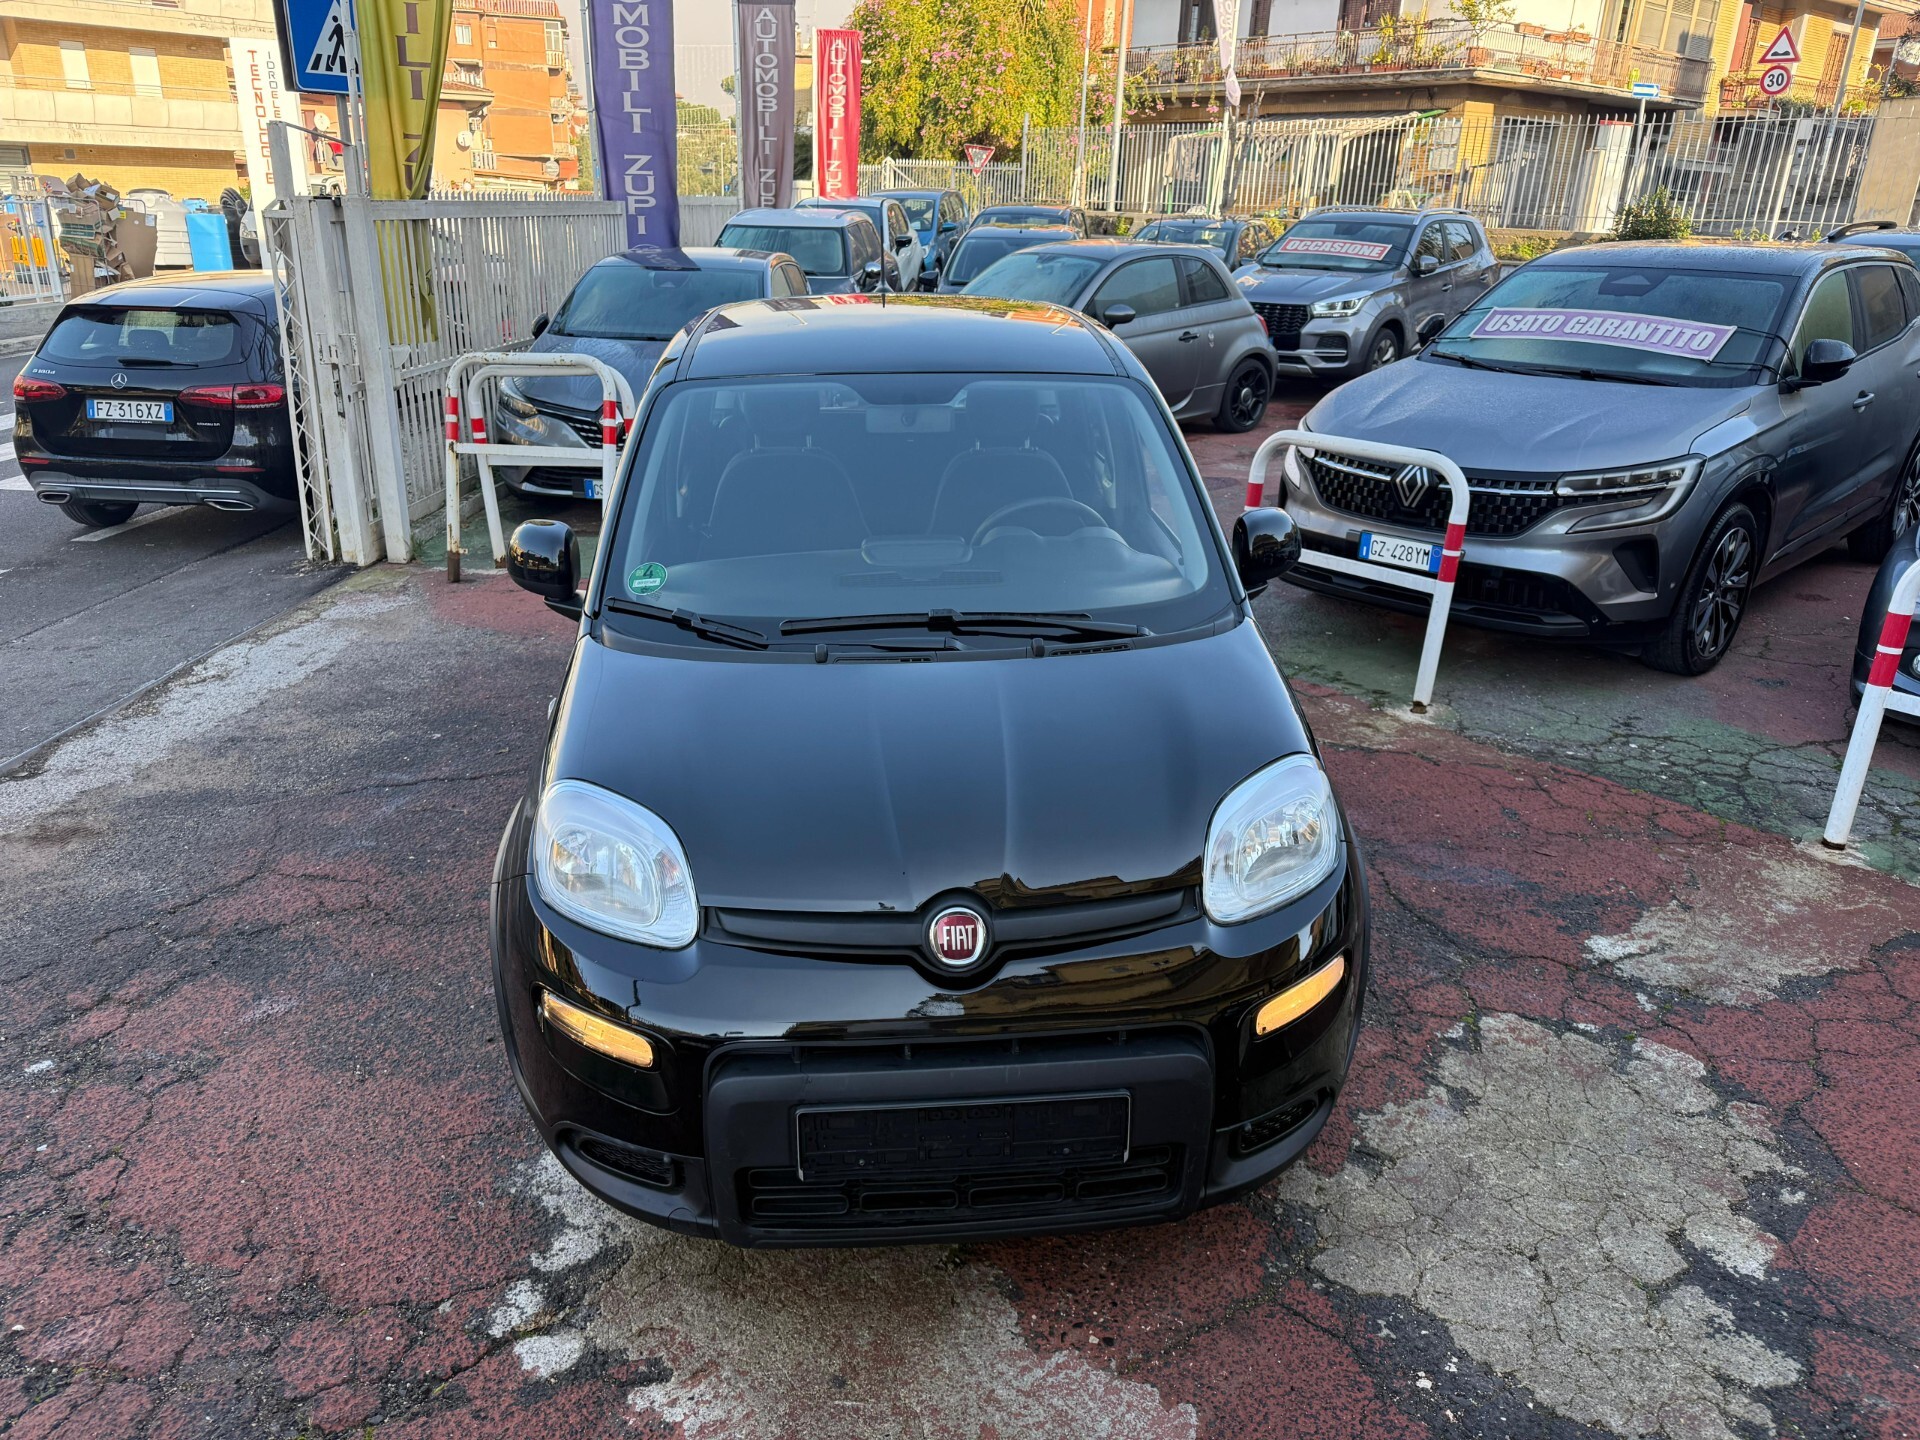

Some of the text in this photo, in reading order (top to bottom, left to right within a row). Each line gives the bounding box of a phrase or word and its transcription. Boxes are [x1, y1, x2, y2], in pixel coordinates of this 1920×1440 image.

[754, 7, 780, 155] AUTOMOBILI
[829, 38, 849, 151] AUTOMOBILI
[1766, 72, 1785, 88] 30
[611, 0, 657, 235] MOBILI ZUPI
[1286, 240, 1384, 257] OCCASIONE
[1484, 314, 1716, 351] USATO GARANTITO
[643, 564, 654, 579] 4
[942, 924, 975, 951] FIAT
